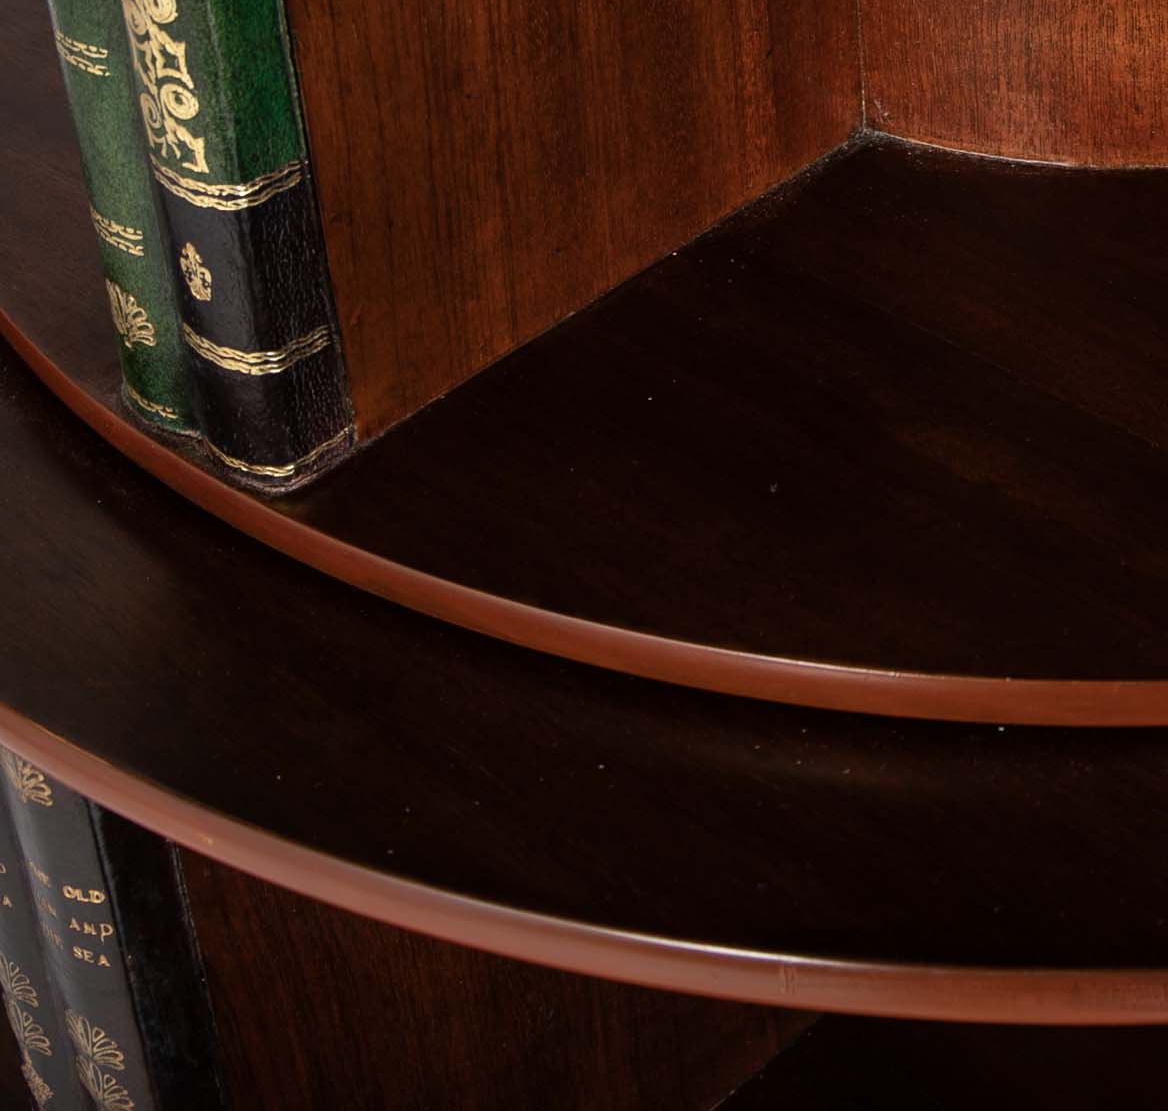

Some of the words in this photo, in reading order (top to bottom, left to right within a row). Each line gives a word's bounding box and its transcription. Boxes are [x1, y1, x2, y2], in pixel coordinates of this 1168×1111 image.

[61, 884, 106, 904] OLD
[69, 917, 114, 943] AND
[72, 945, 111, 968] SEA
